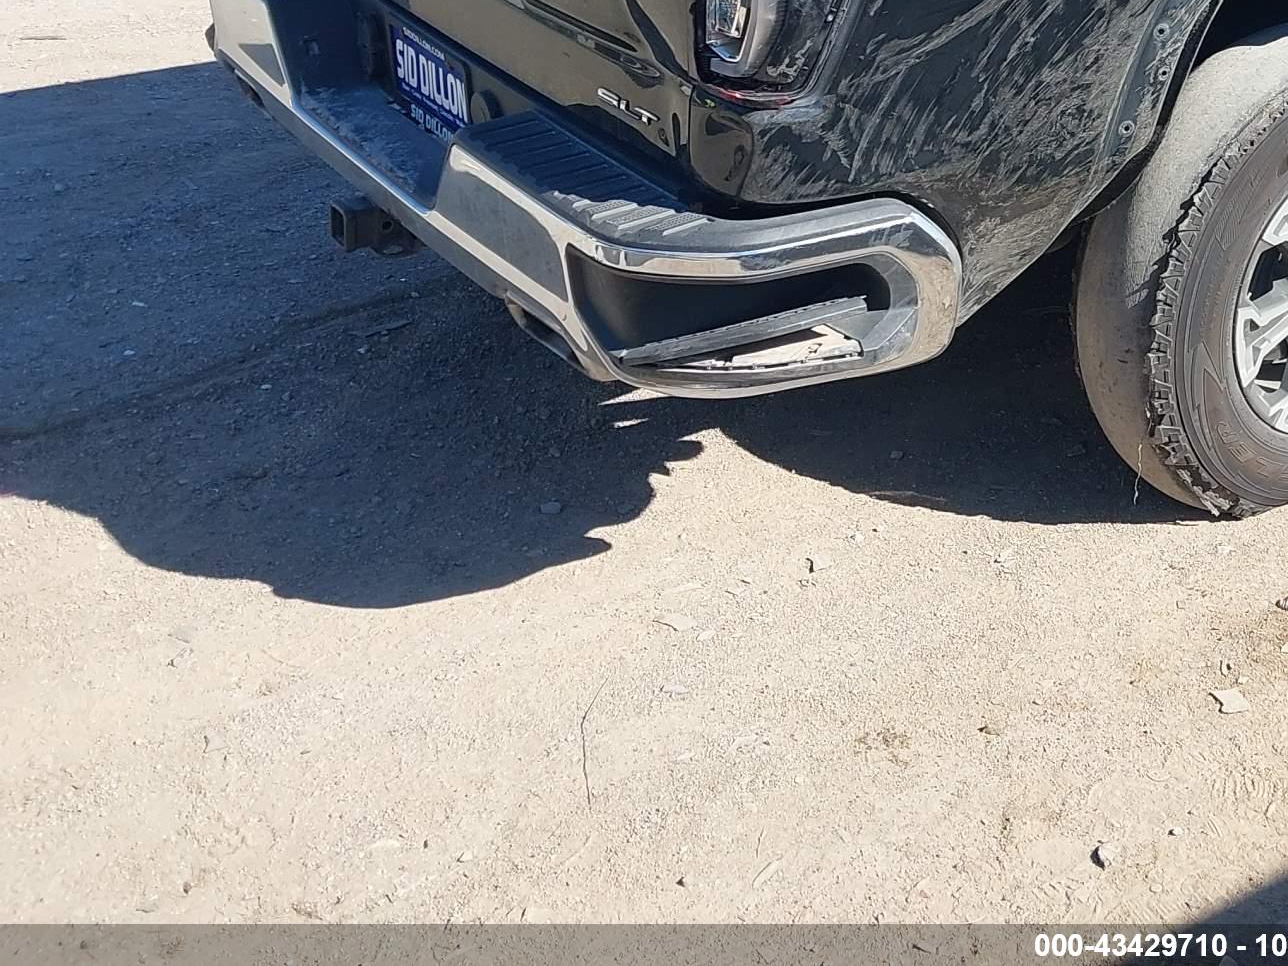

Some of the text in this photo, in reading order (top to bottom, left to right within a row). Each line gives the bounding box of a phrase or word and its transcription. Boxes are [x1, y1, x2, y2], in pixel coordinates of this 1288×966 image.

[396, 38, 418, 89] SID
[418, 53, 468, 124] DILLON
[410, 103, 424, 125] SID
[597, 87, 660, 126] SLT
